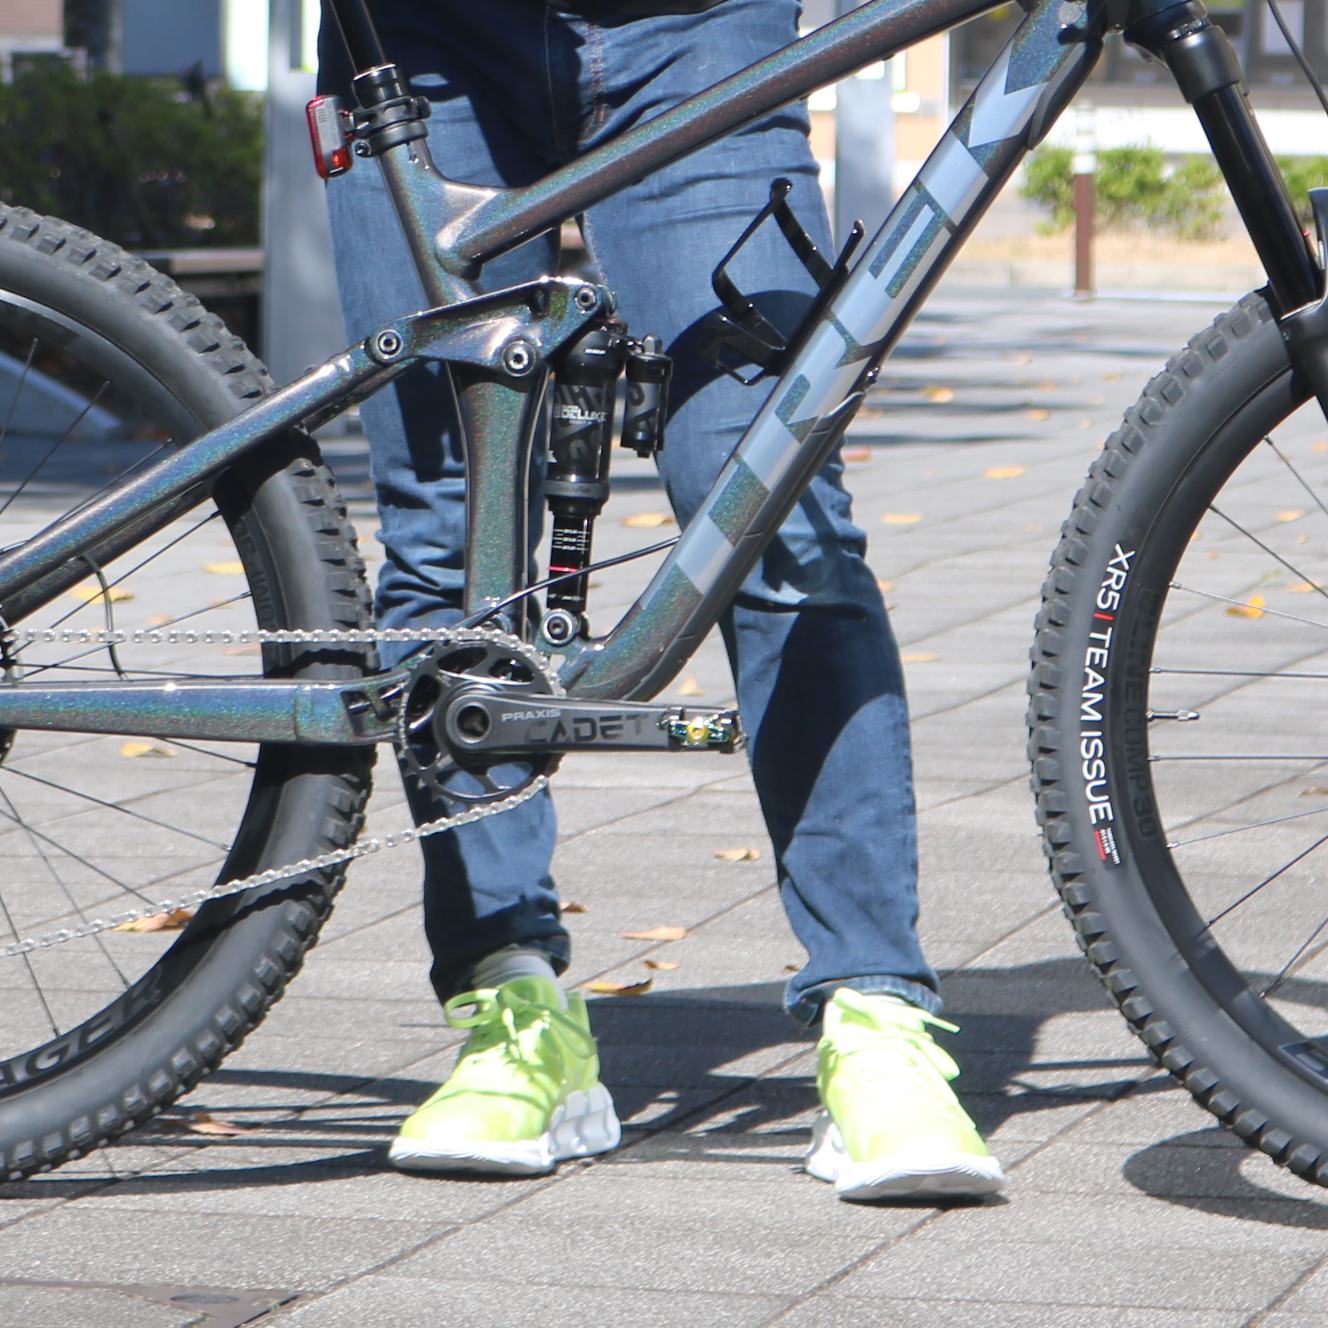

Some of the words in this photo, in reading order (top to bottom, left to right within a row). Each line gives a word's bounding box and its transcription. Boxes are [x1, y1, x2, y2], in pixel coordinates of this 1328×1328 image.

[640, 33, 1050, 603] TREK
[1095, 543, 1136, 611] XR5
[1080, 627, 1113, 722] TEAM
[501, 708, 561, 723] PRAXIS
[525, 712, 650, 744] CADET
[1080, 731, 1114, 825] ISSUE
